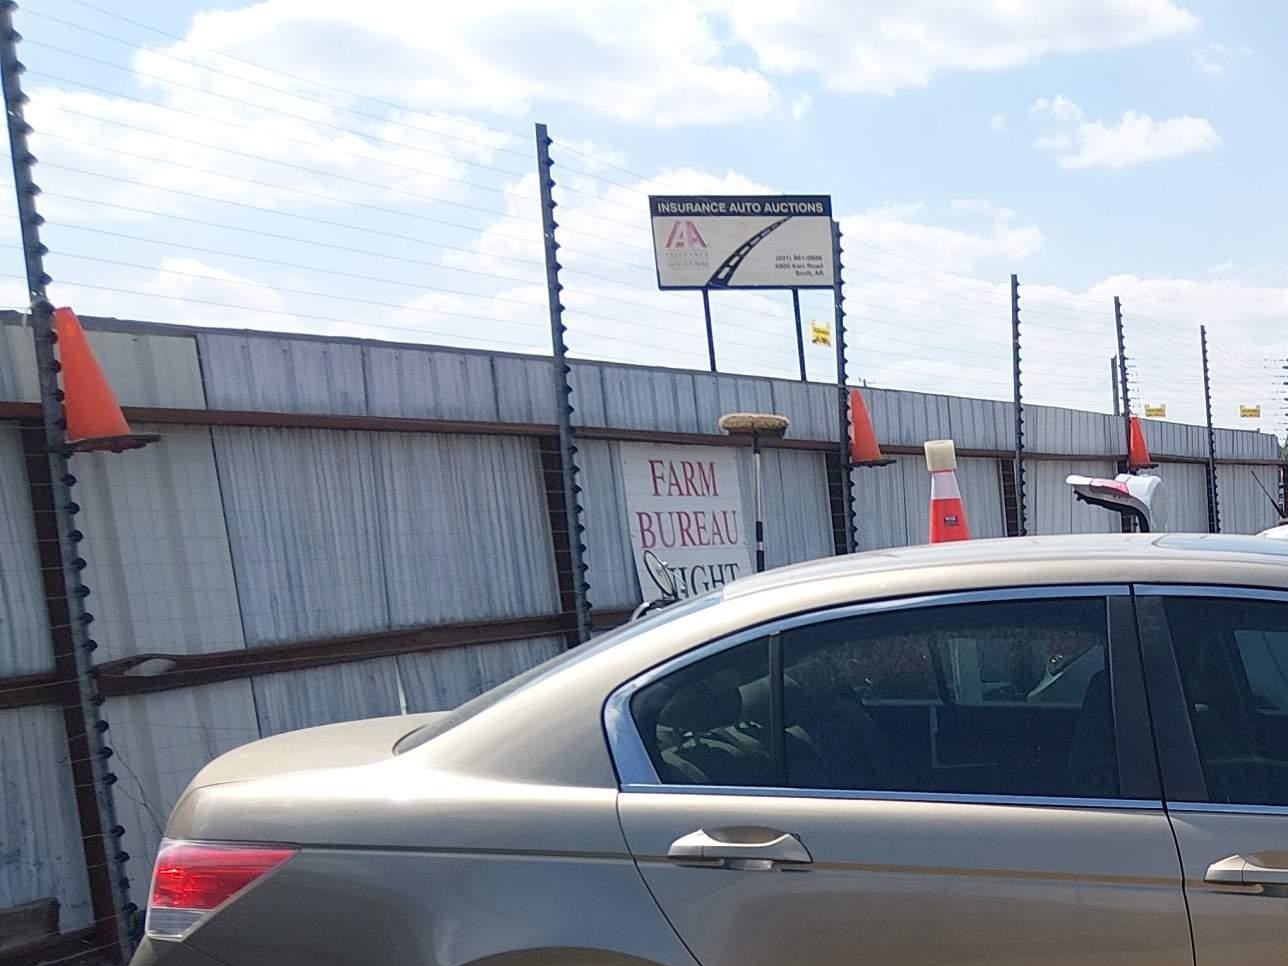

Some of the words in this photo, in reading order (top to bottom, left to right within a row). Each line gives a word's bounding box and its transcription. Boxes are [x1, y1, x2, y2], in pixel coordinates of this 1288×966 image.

[657, 202, 726, 213] INSURANCE
[730, 202, 761, 213] AUTO
[764, 202, 824, 213] AUCTIONS
[648, 459, 719, 497] FARM
[636, 510, 739, 550] BUREAU
